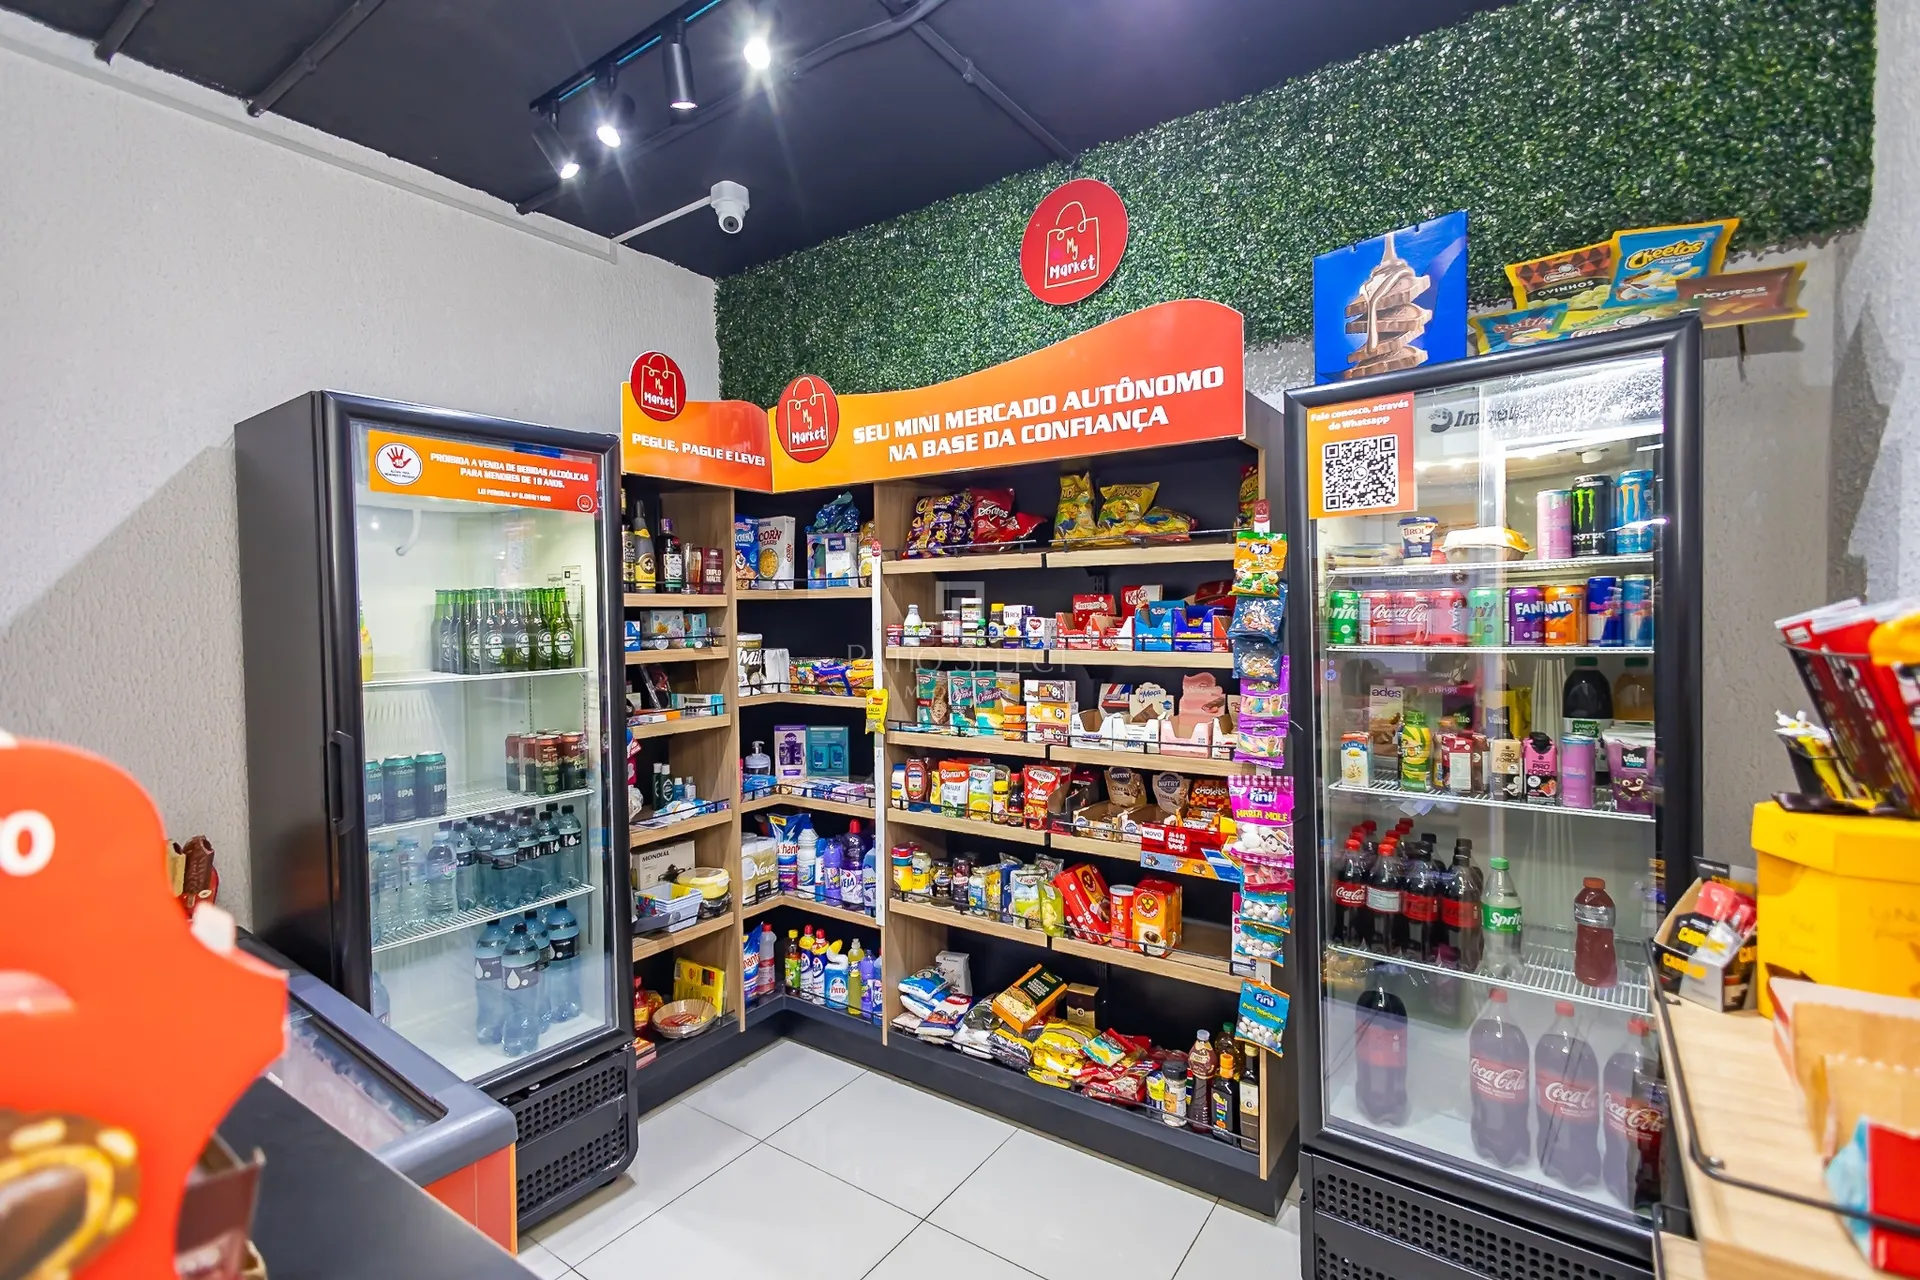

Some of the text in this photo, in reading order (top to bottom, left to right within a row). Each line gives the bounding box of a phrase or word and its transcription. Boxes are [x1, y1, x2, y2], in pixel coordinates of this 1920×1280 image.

[1066, 237, 1079, 261] My
[1627, 240, 1705, 269] Cheetos
[1049, 254, 1096, 279] Market
[1537, 280, 1595, 297] OVINHOS
[654, 377, 664, 396] My
[643, 391, 675, 409] Market
[853, 365, 1224, 444] SEU MINI MERCADO AUTÔNOMO
[802, 408, 813, 430] My
[1310, 398, 1410, 422] Fale conosco, através
[1341, 414, 1391, 430] Whatsapp
[792, 426, 828, 445] Market
[888, 405, 1169, 462] NA BASE DA CONFIANÇA
[631, 432, 679, 454] PEGUE,
[682, 442, 724, 460] PAGUE
[725, 449, 733, 461] E
[429, 452, 470, 466] PROIBIDA
[471, 459, 478, 468] A
[478, 459, 505, 471] VENDA
[506, 463, 517, 473] DE
[516, 464, 548, 477] BEBIDAS
[460, 467, 483, 478] PARA
[484, 470, 521, 483] MENORES
[521, 475, 532, 485] DE
[978, 507, 1009, 519] Doritos
[759, 527, 783, 542] CORN
[786, 543, 794, 563] CORN
[1371, 687, 1402, 698] ades
[1622, 755, 1646, 764] Valle
[397, 789, 415, 799] IPA
[1249, 789, 1277, 803] Fini
[1144, 830, 1162, 838] NOVO
[641, 850, 670, 862] MONDIAL
[752, 861, 776, 877] Neve
[830, 986, 846, 994] PATO
[1255, 992, 1276, 1008] Fini
